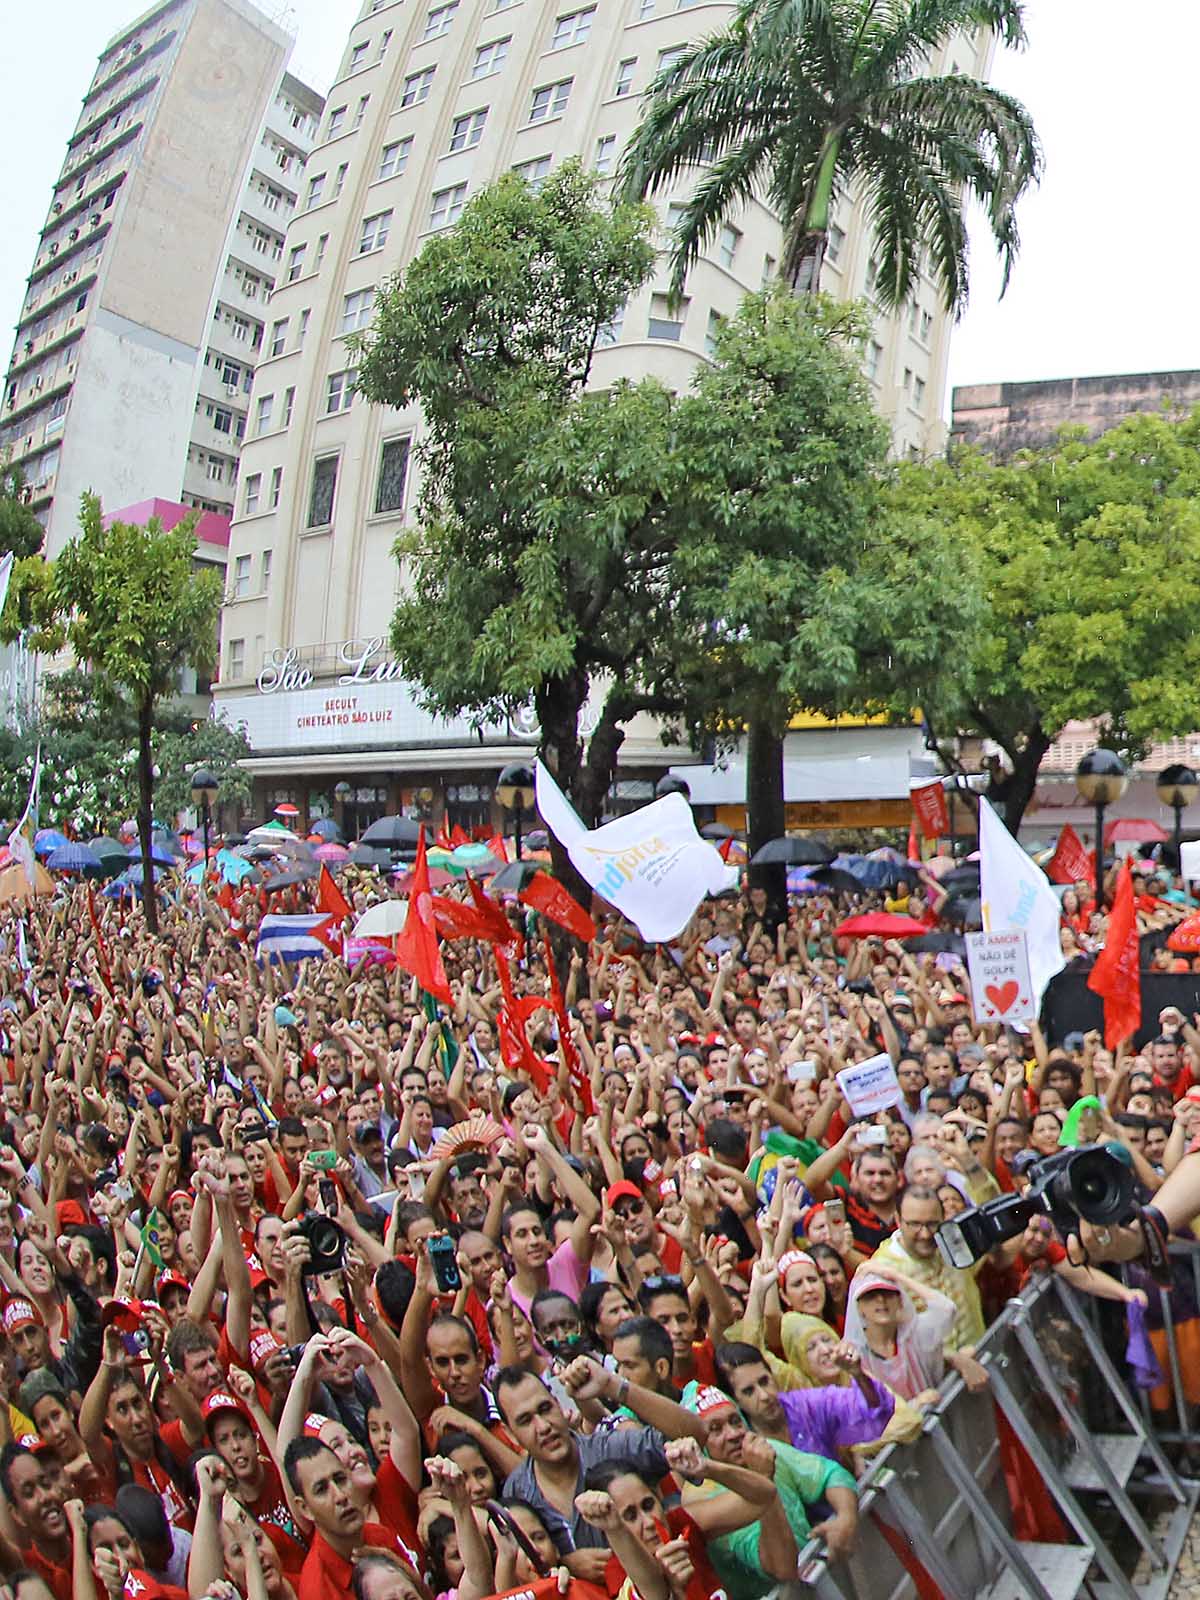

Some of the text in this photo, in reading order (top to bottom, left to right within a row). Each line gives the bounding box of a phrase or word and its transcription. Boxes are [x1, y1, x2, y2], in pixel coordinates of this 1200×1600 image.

[257, 648, 314, 694] São
[325, 698, 358, 712] SECULT
[297, 713, 350, 729] CINETEATRO
[370, 710, 393, 722] LUIZ
[987, 934, 1021, 945] AMOR
[978, 948, 1017, 961] NÃO DÊ
[983, 966, 1016, 976] GOLPE
